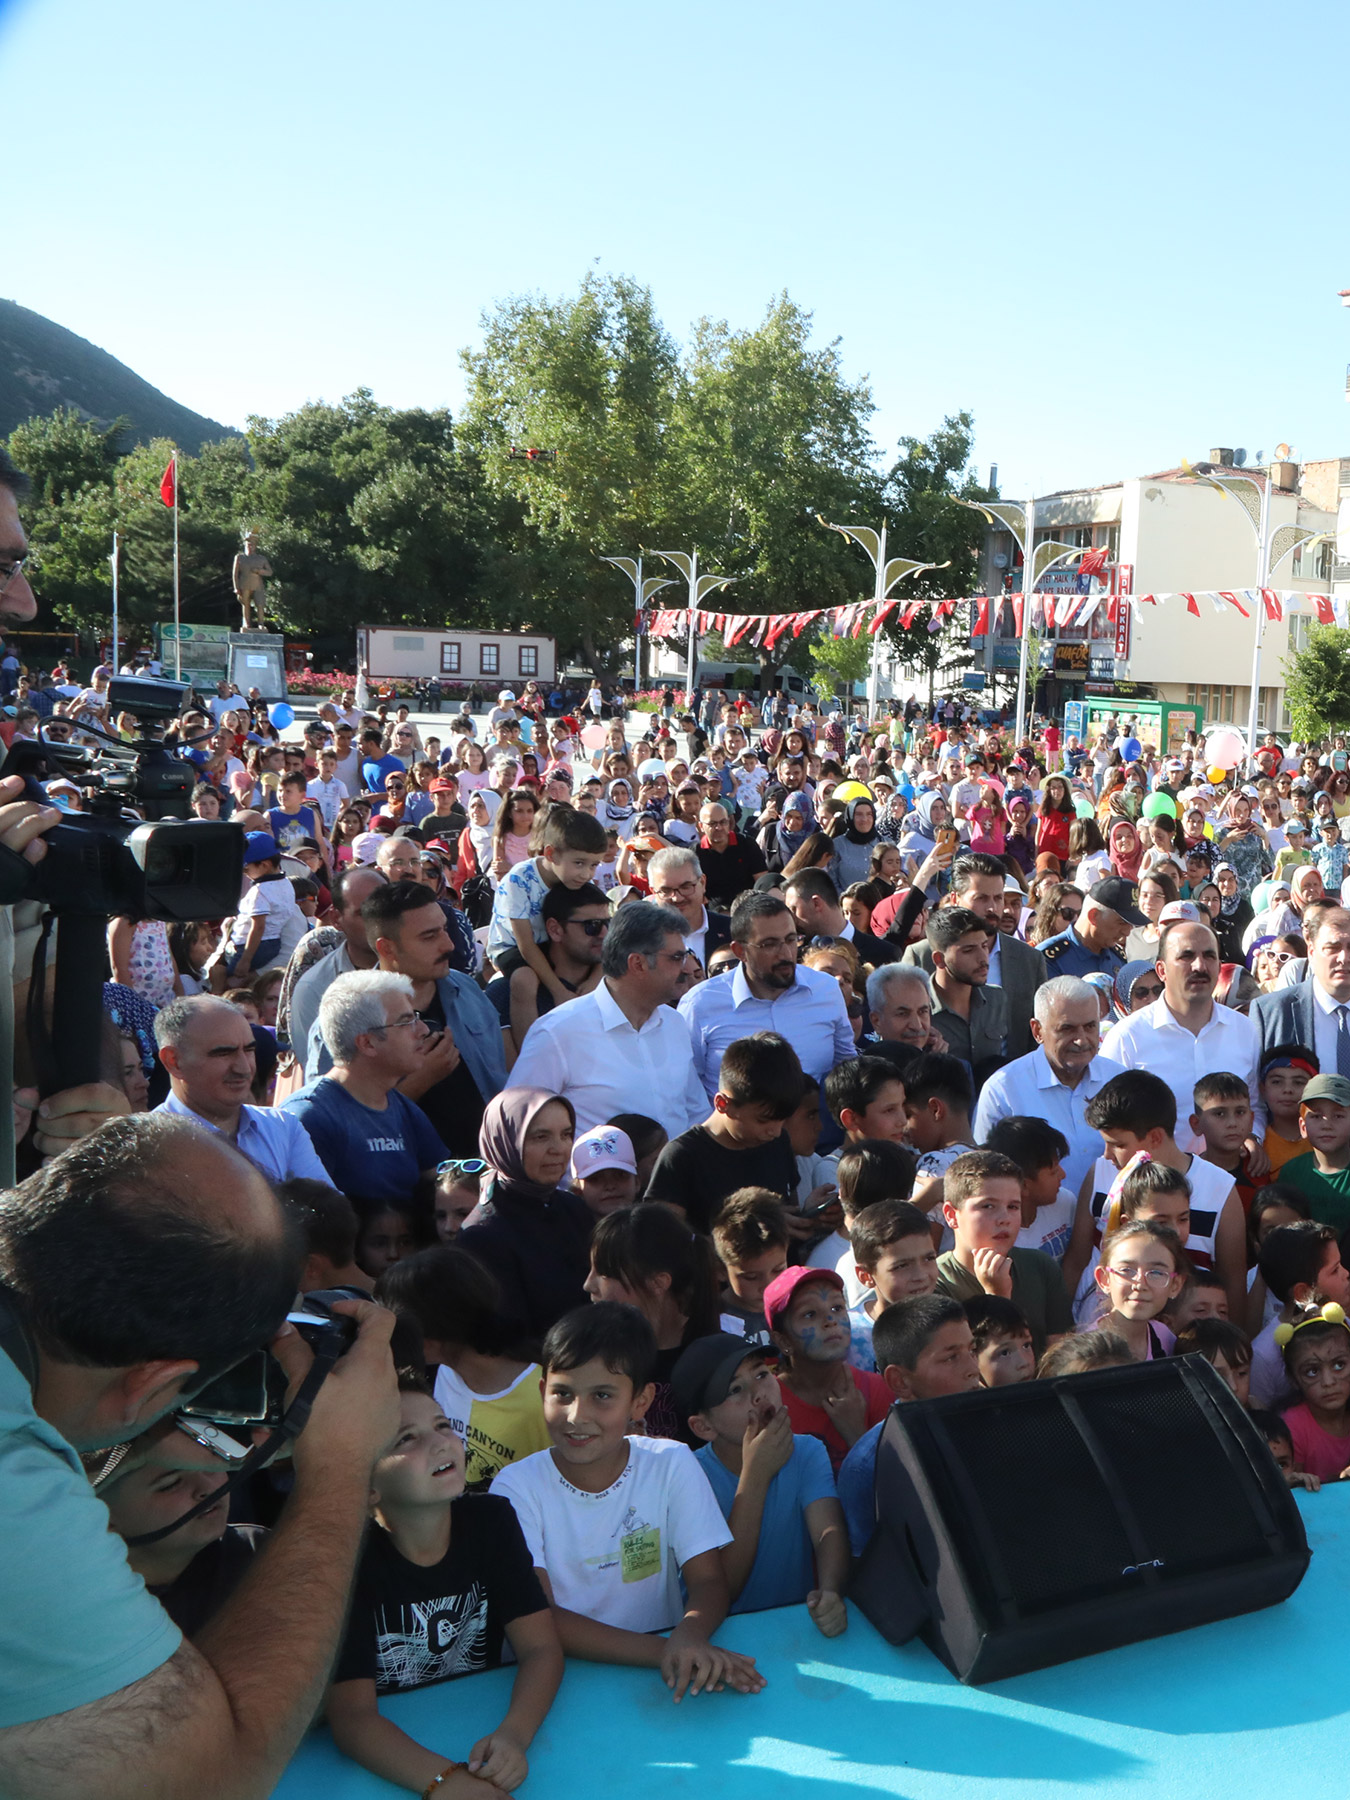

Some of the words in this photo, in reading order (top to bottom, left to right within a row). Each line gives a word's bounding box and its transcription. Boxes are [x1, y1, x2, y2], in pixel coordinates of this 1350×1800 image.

[1118, 579, 1128, 652] DEMOKRAT
[366, 1133, 405, 1152] mavi
[465, 1425, 516, 1460] CANYON
